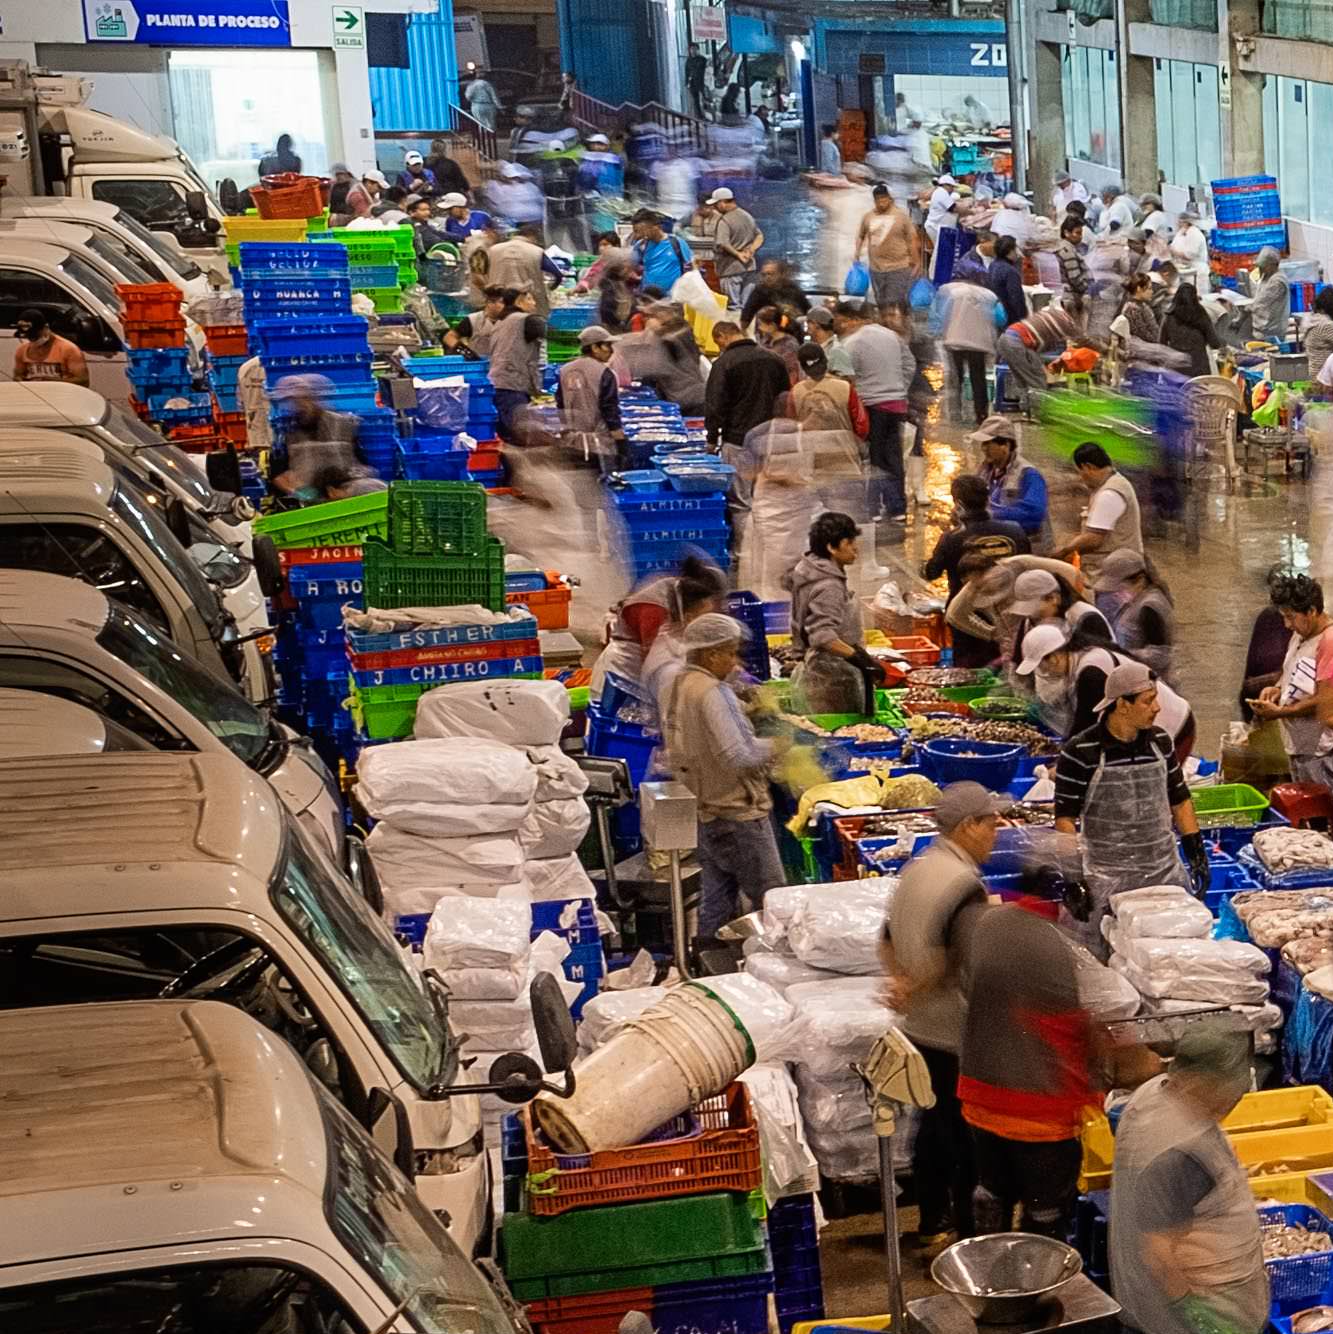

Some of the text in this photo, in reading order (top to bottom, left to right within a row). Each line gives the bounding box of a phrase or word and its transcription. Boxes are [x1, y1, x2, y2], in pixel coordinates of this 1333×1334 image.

[146, 14, 280, 28] PLANTA DE PROCESO
[336, 38, 362, 46] SALIDA
[399, 625, 495, 648] ESTHER
[373, 658, 525, 685] J CHIIRO A
[568, 929, 580, 944] M
[571, 964, 583, 980] M
